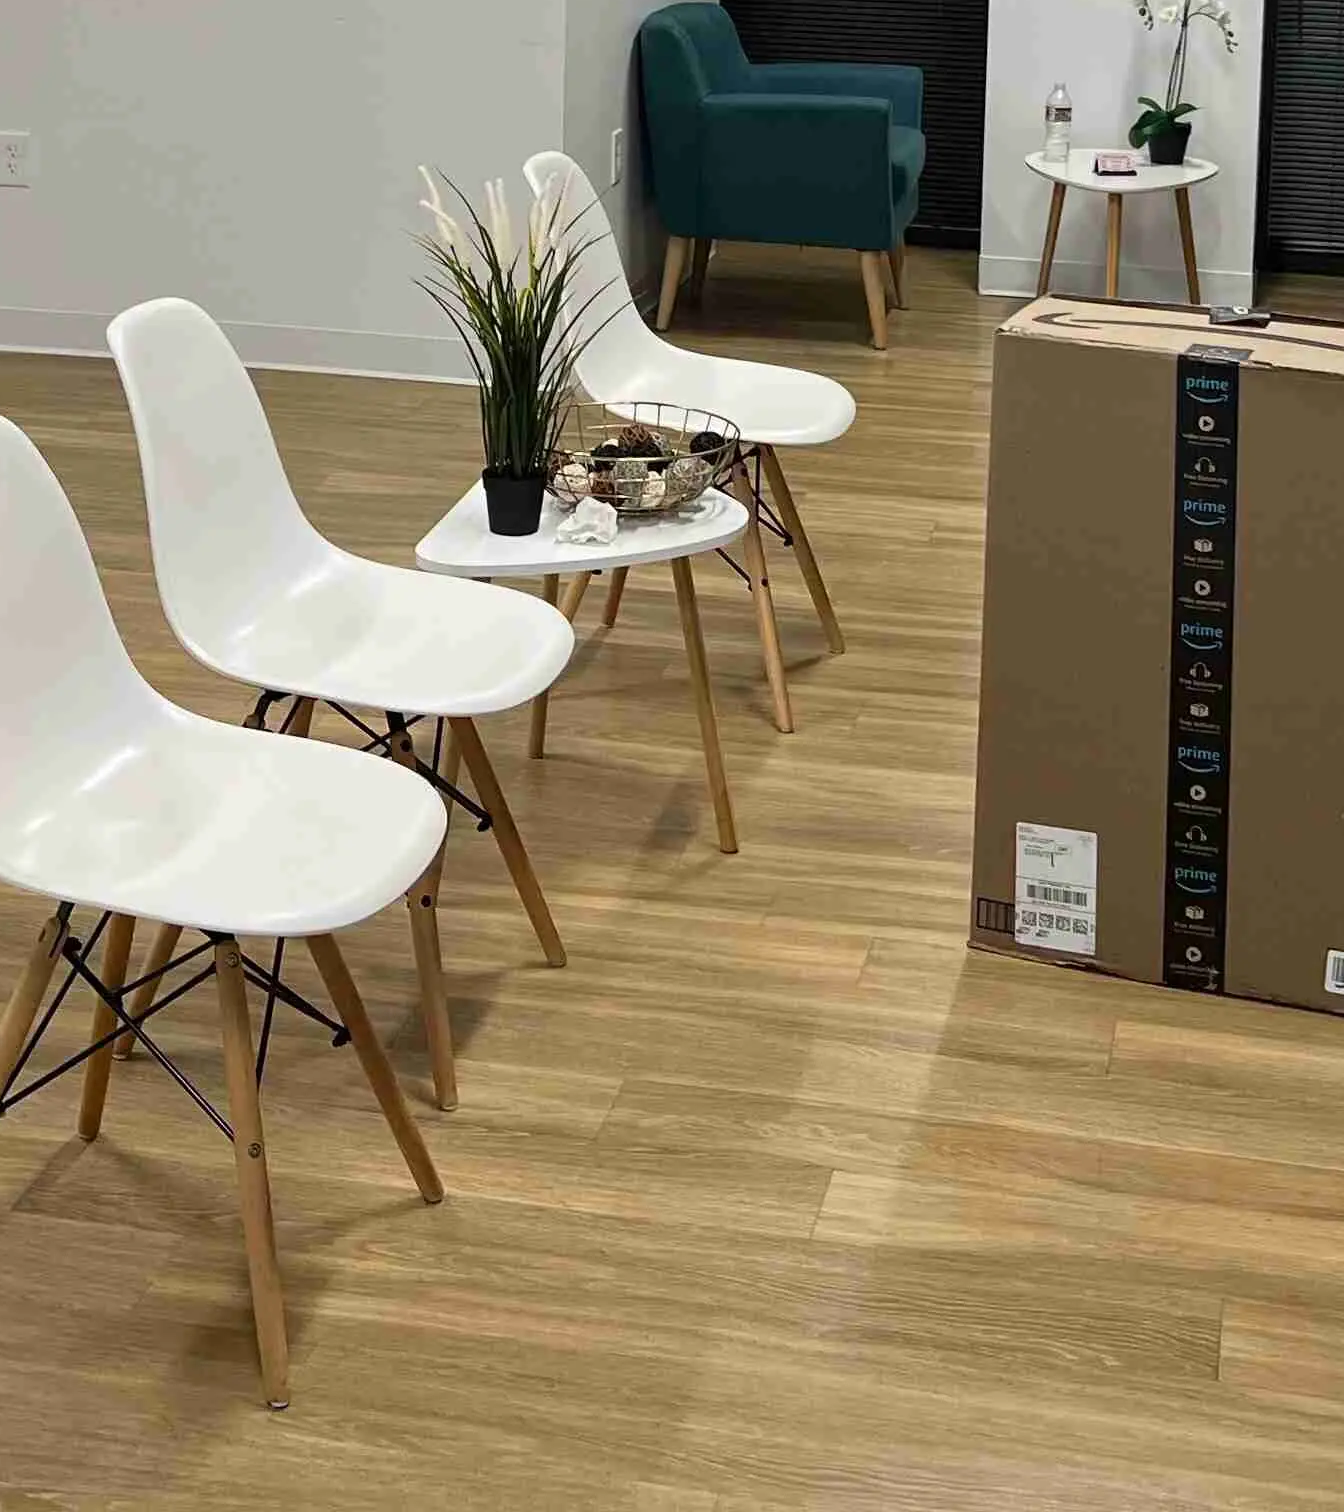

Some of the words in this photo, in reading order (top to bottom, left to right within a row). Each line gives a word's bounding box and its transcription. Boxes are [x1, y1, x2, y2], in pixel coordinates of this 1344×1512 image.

[1185, 375, 1229, 391] prime
[1183, 498, 1227, 514] prime
[1180, 622, 1223, 638] prime
[1177, 745, 1220, 761] prime
[1174, 866, 1217, 882] prime
